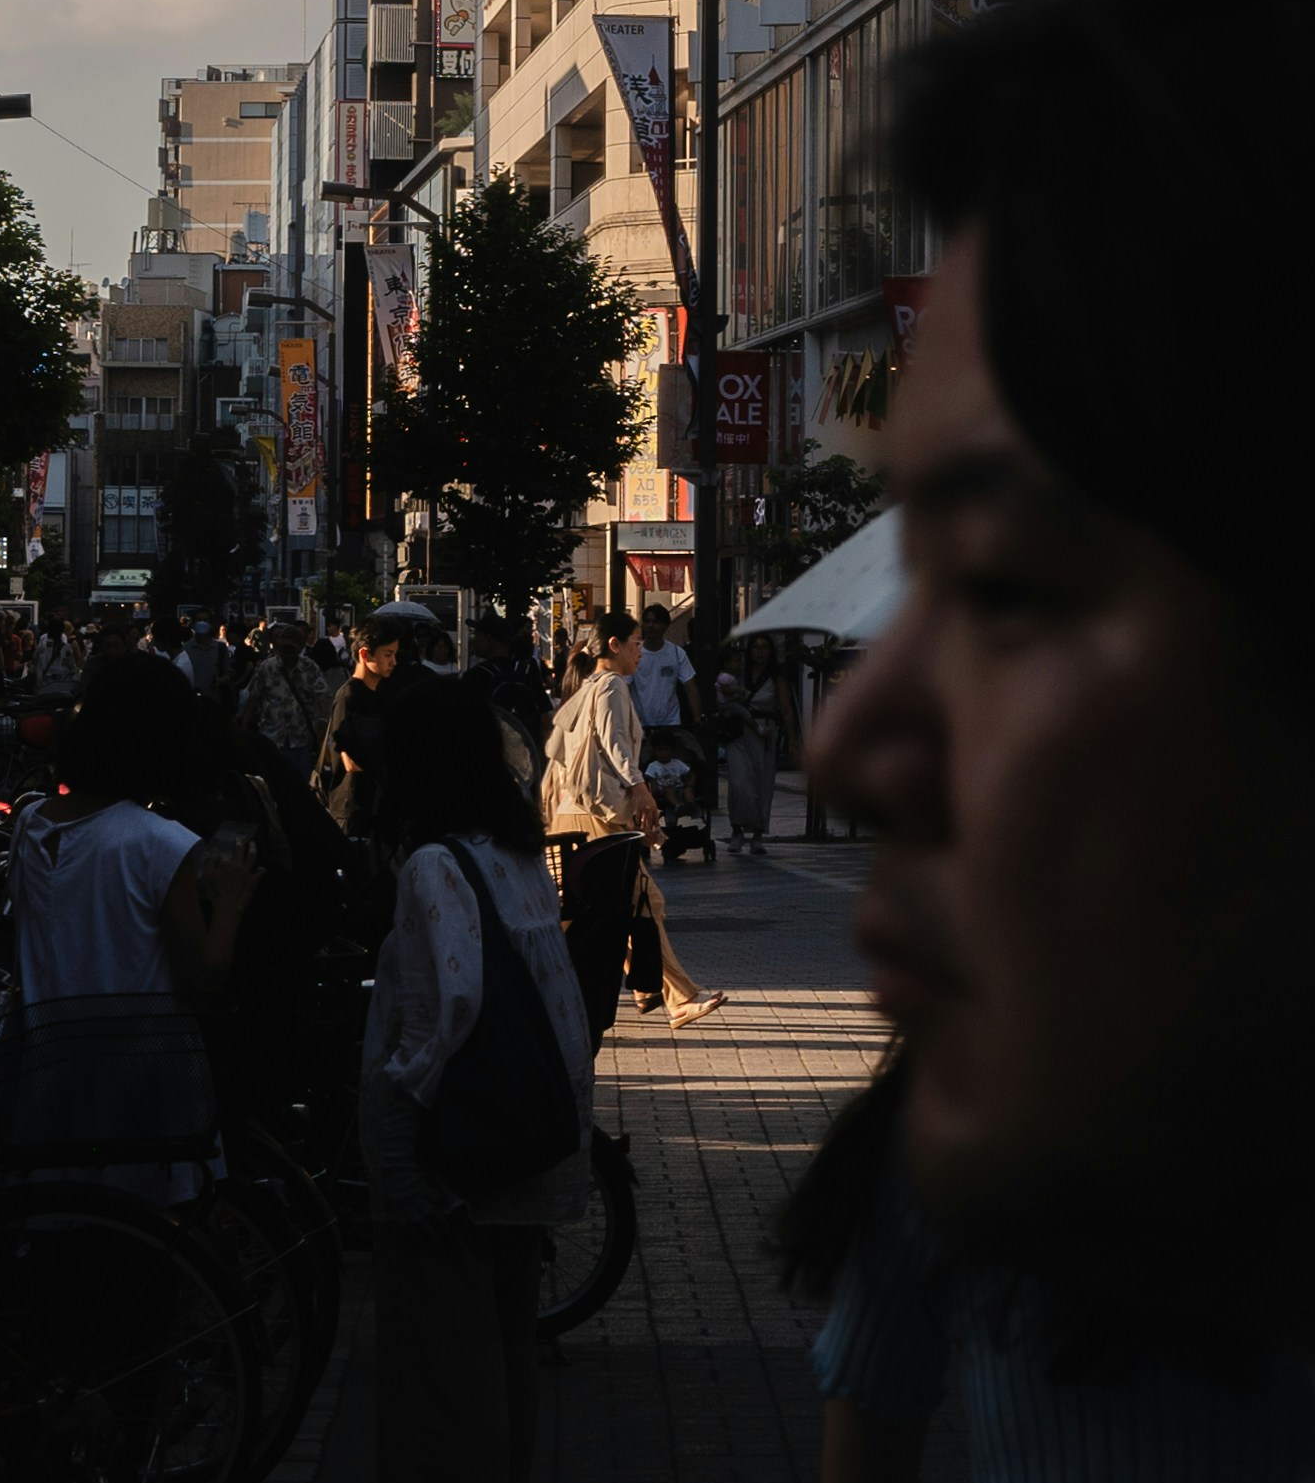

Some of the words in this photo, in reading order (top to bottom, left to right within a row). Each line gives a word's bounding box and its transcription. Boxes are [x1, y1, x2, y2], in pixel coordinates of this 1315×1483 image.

[599, 23, 645, 35] THEATER
[718, 374, 763, 400] OX
[289, 363, 315, 442] 電気館
[717, 403, 762, 426] ALE
